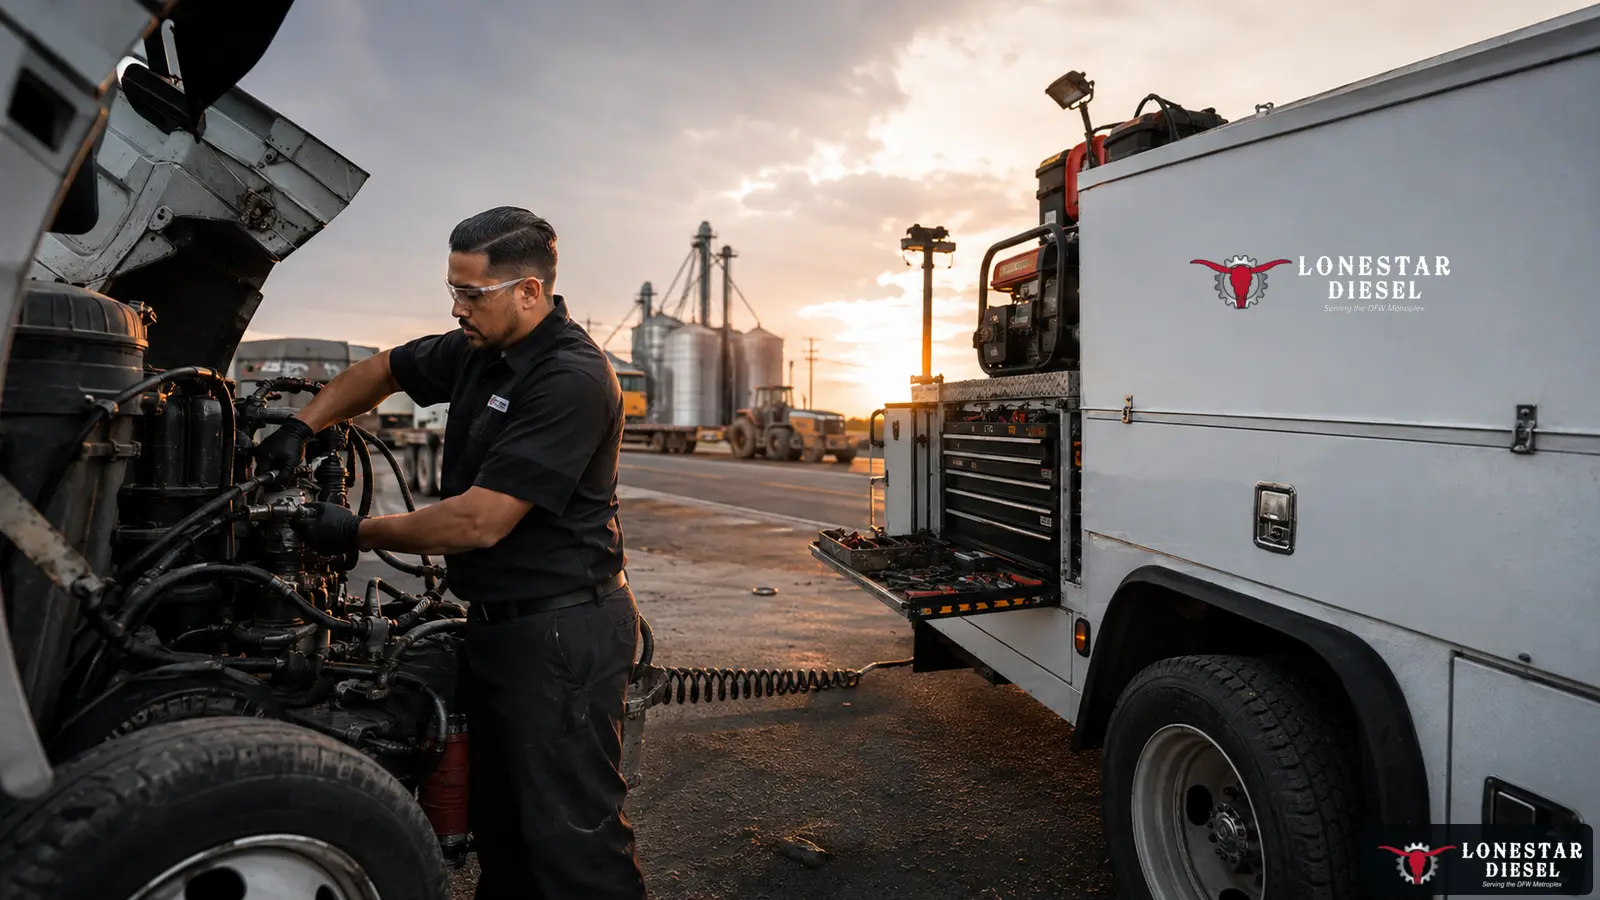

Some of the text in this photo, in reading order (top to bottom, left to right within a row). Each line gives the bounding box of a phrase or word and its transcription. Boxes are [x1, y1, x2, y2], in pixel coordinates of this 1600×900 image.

[1298, 255, 1451, 276] LONESTAR
[1328, 280, 1422, 300] DIESEL
[1323, 304, 1424, 314] Serving the DFW Metroplex
